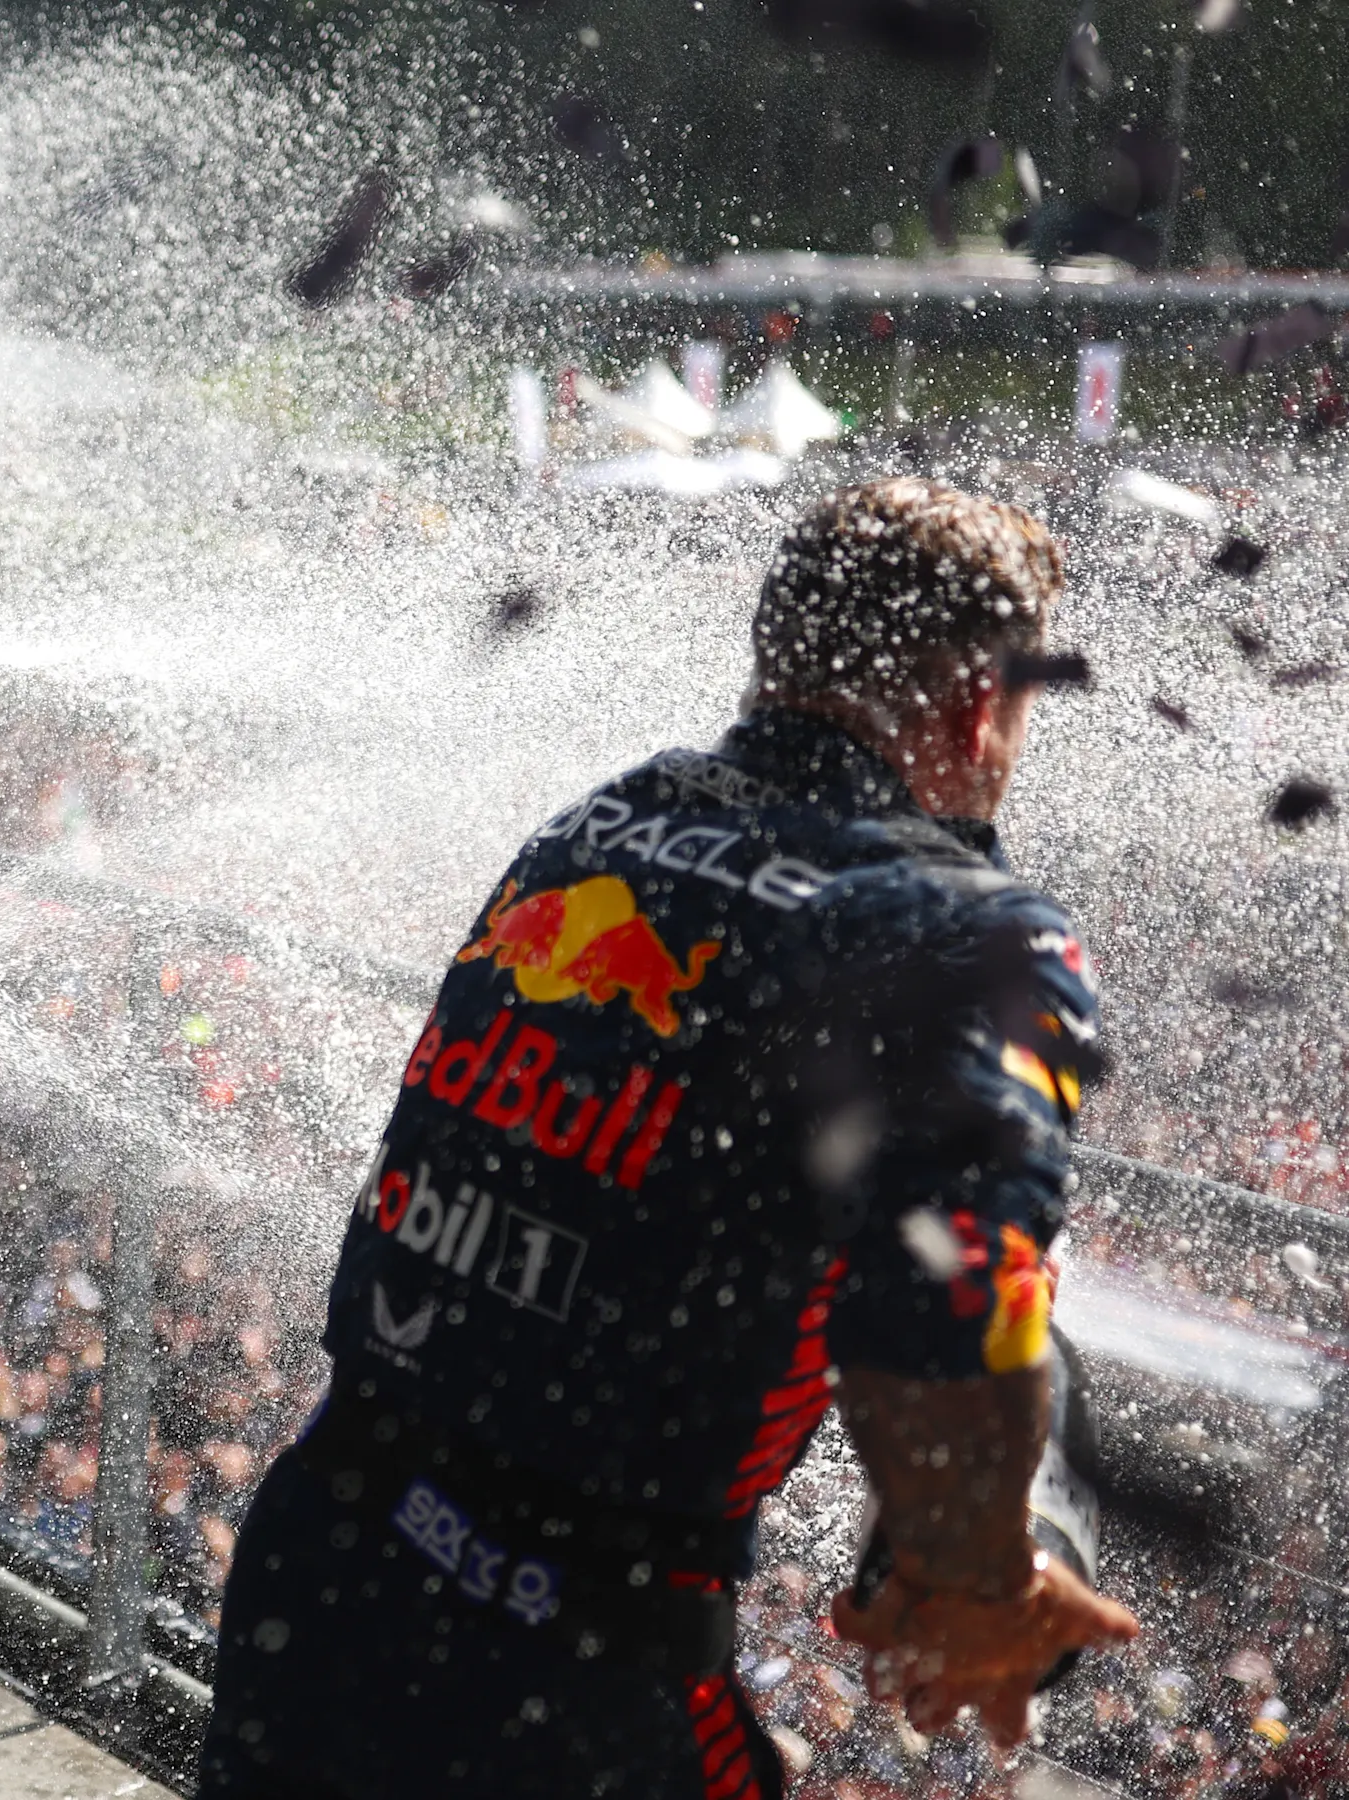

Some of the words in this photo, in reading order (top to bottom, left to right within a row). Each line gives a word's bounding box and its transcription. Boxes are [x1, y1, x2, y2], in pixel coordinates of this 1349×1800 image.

[536, 793, 837, 910] ORACLE
[403, 1004, 515, 1107] ed
[473, 1023, 684, 1190] Bull
[519, 1229, 550, 1302] 1
